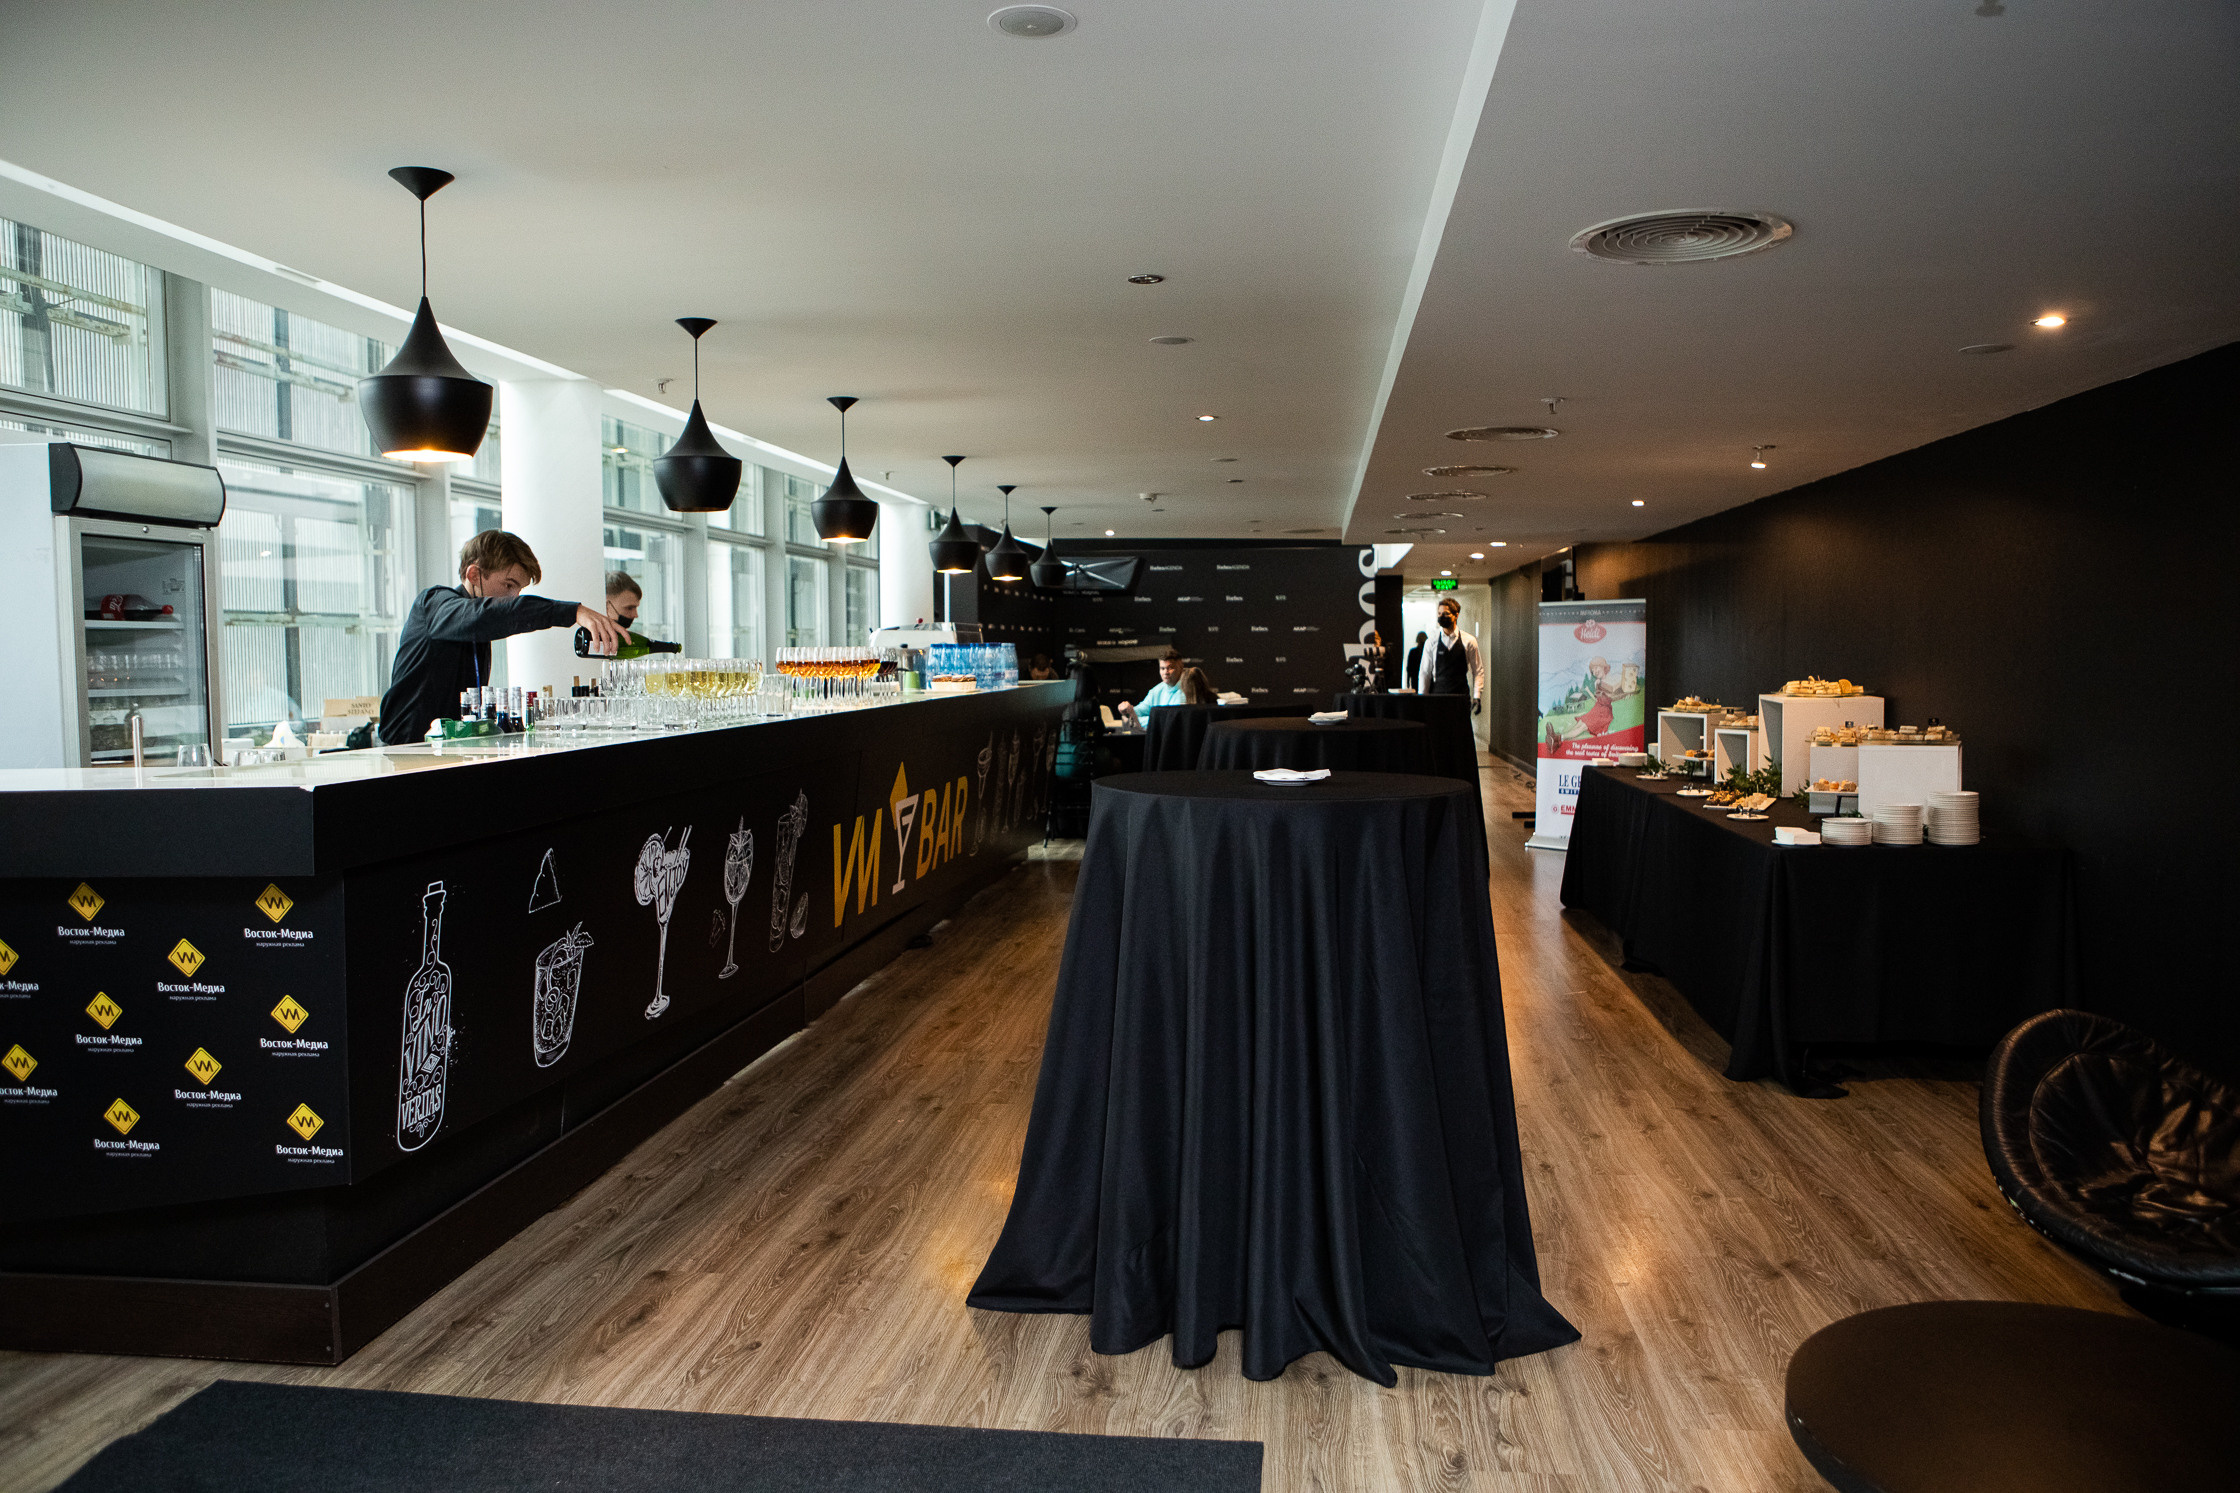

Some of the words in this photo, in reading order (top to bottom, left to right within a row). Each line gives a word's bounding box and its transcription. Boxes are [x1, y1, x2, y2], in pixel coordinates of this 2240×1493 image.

[1559, 775, 1569, 787] LE
[916, 776, 968, 880] BAR
[57, 926, 126, 938] Восток-Медиа
[243, 927, 314, 940] Восток-Медиа
[0, 981, 40, 992] к-Медиа
[157, 982, 226, 994] Восток-Медиа
[75, 1034, 143, 1045] Восток-Медиа
[259, 1038, 329, 1050] Восток-Медиа
[404, 994, 447, 1083] VINO
[0, 1087, 58, 1098] осток-Медиа
[174, 1089, 242, 1101] Восток-Медиа
[401, 1083, 442, 1130] VERITAS
[94, 1139, 160, 1151] Восток-Медиа
[276, 1144, 344, 1157] Восток-Медиа
